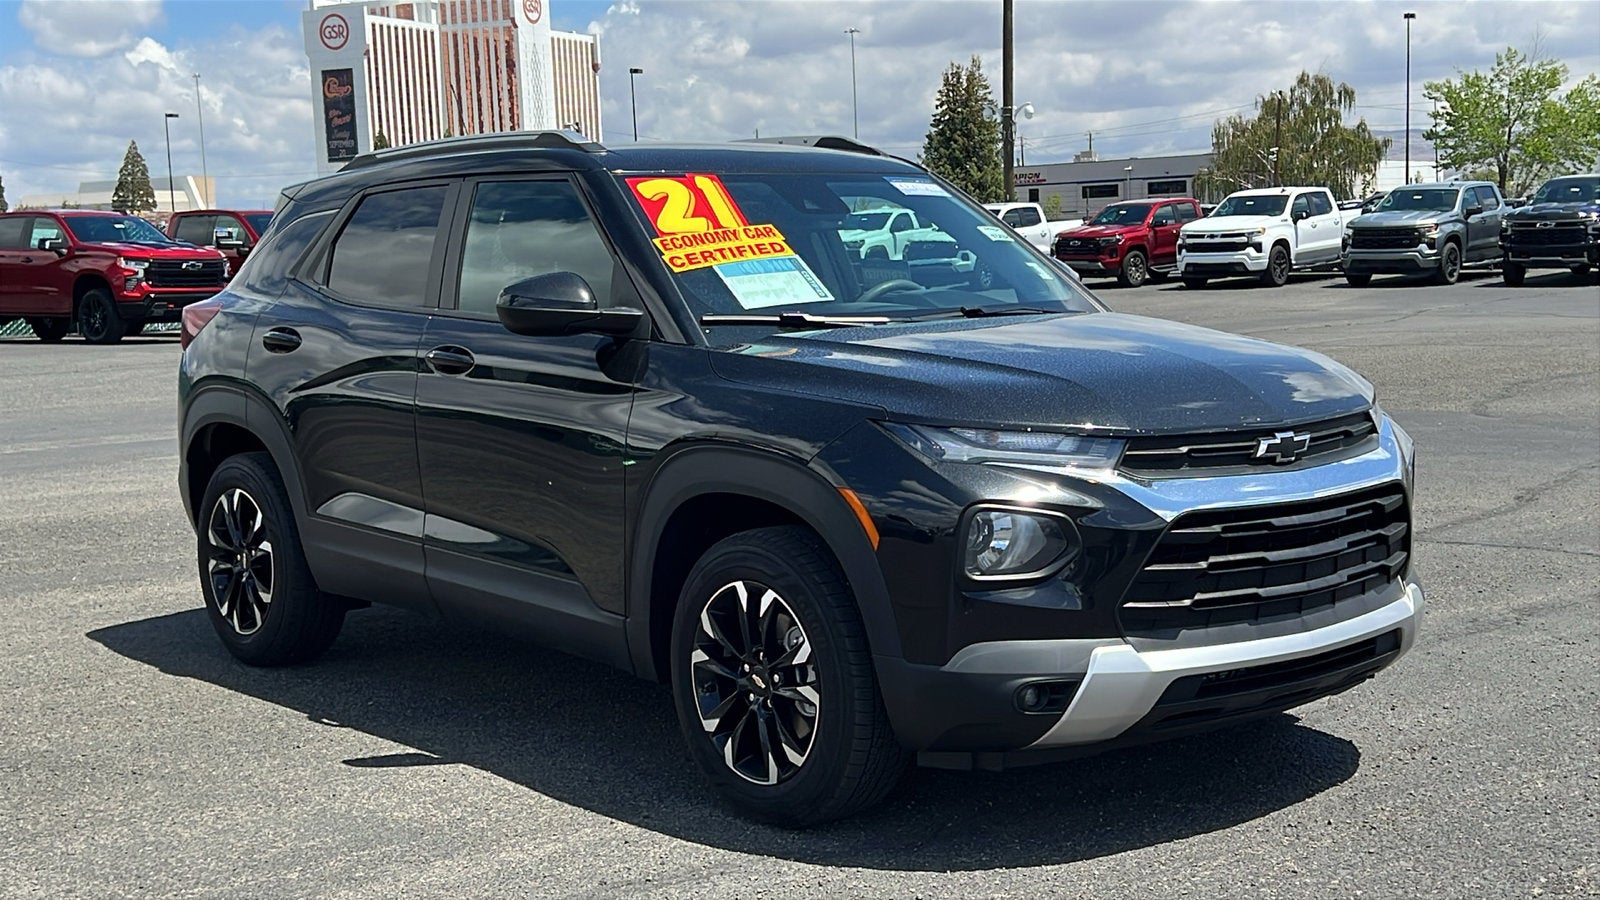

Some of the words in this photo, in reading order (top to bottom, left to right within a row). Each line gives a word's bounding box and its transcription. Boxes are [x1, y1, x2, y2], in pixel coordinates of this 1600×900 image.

[323, 24, 345, 39] GSR
[636, 175, 742, 233] 21
[659, 229, 741, 252] ECONOMY
[745, 226, 777, 240] CAR
[668, 242, 786, 268] CERTIFIED
